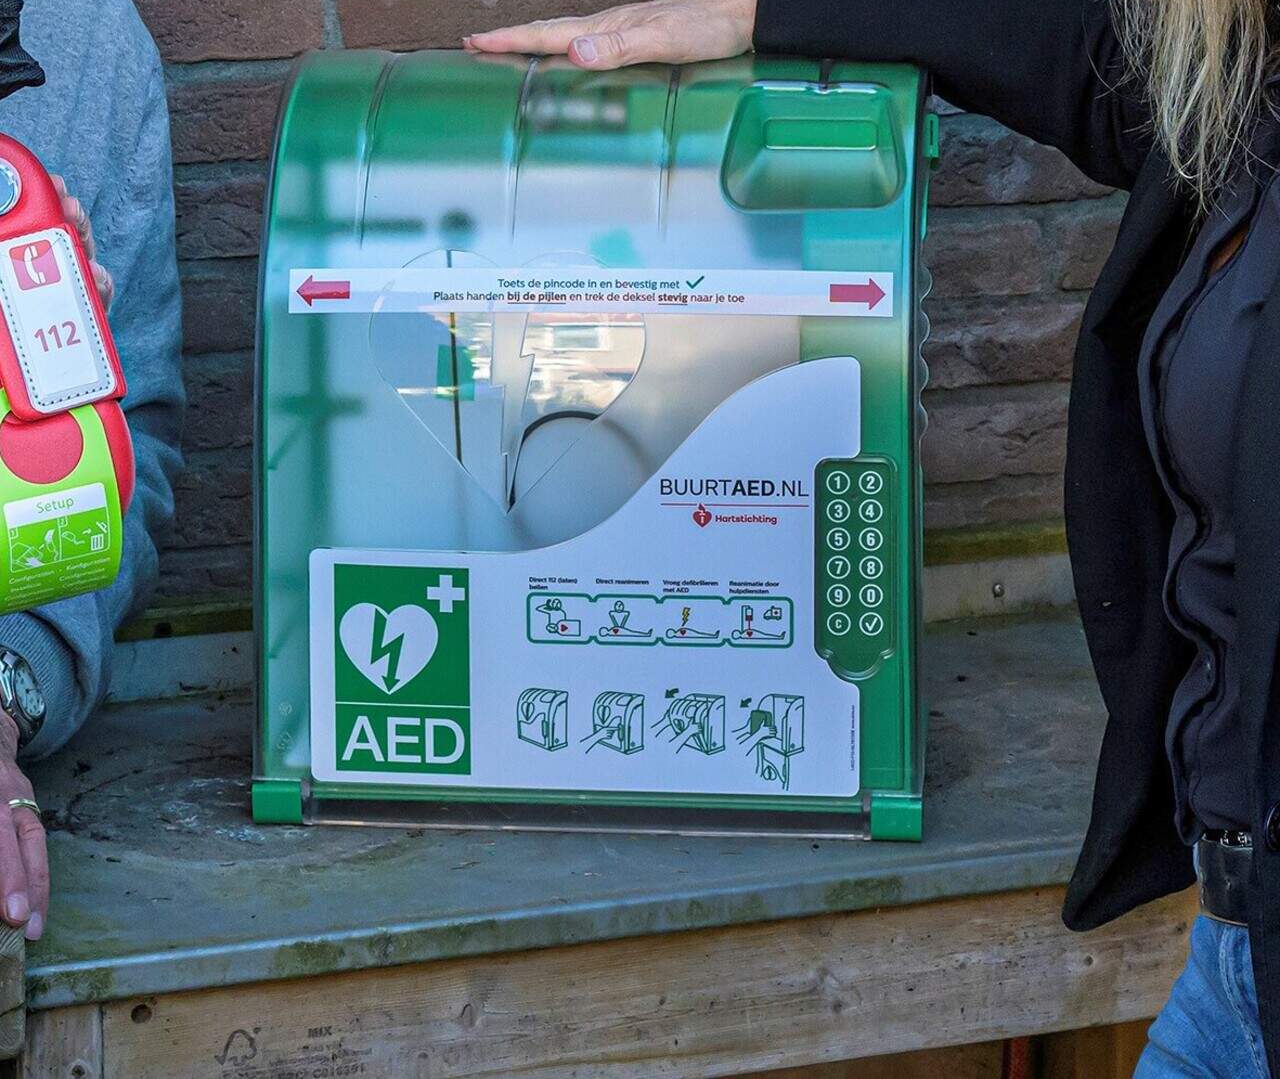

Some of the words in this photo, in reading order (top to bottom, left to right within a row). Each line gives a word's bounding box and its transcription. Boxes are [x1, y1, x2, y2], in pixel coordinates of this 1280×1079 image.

[498, 278, 525, 288] Toets
[528, 278, 541, 288] de
[543, 278, 585, 290] pincode
[588, 279, 597, 289] in
[600, 281, 612, 289] en
[615, 279, 657, 291] bevestig
[659, 280, 680, 289] met
[433, 291, 464, 301] Plaats
[466, 291, 504, 301] handen
[507, 291, 520, 302] bij
[523, 292, 535, 301] de
[538, 292, 566, 303] pijlen
[569, 293, 582, 301] en
[585, 292, 604, 302] trek
[606, 292, 620, 302] de
[622, 292, 656, 302] deksel
[658, 293, 688, 304] stevig
[690, 294, 713, 303] naar
[715, 294, 725, 304] je
[728, 294, 745, 303] toe
[34, 321, 81, 352] 112
[660, 478, 809, 497] BUURTAED.NL
[834, 476, 841, 489] 1
[866, 475, 875, 490] 2
[35, 497, 74, 513] Setup
[834, 504, 843, 518] 3
[865, 504, 875, 518] 4
[715, 514, 778, 525] Hartstichting
[834, 533, 843, 547] 5
[866, 533, 875, 547] 6
[834, 561, 843, 575] 7
[866, 561, 875, 575] 8
[834, 589, 843, 603] 9
[866, 589, 875, 603] 0
[341, 715, 465, 764] AED
